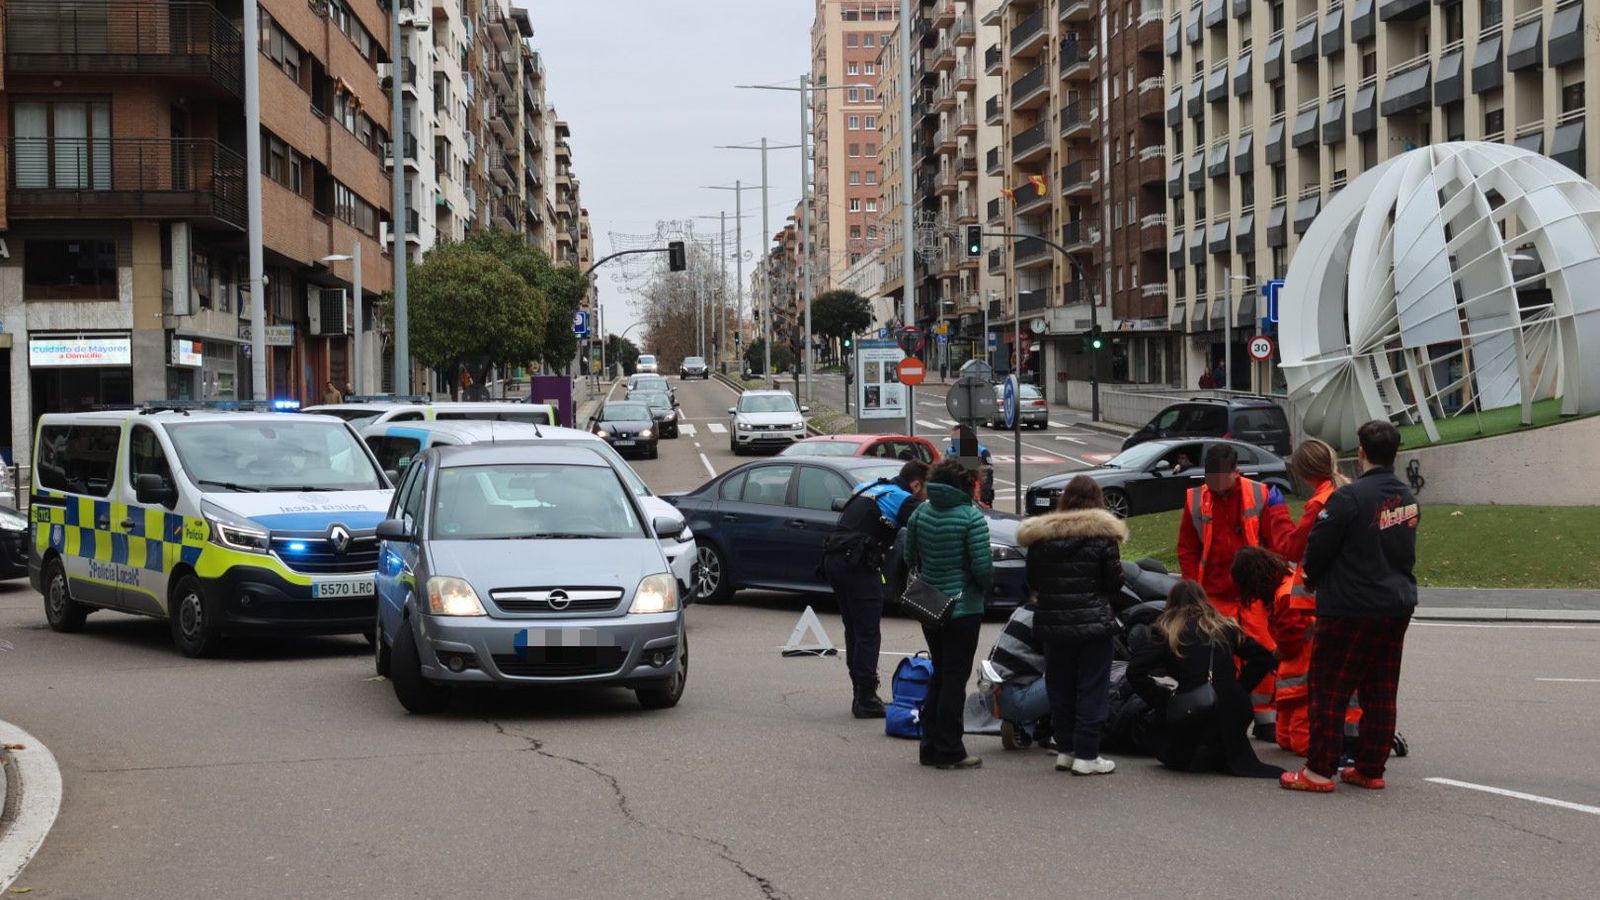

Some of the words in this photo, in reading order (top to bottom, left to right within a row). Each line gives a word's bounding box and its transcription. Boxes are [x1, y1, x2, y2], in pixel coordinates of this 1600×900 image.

[880, 328, 887, 337] P
[32, 344, 72, 353] Cuidado
[74, 344, 86, 353] de
[89, 343, 127, 354] Mayores
[1254, 343, 1267, 352] 30
[116, 565, 136, 585] Local
[321, 584, 349, 595] 5570
[352, 582, 373, 594] LRC
